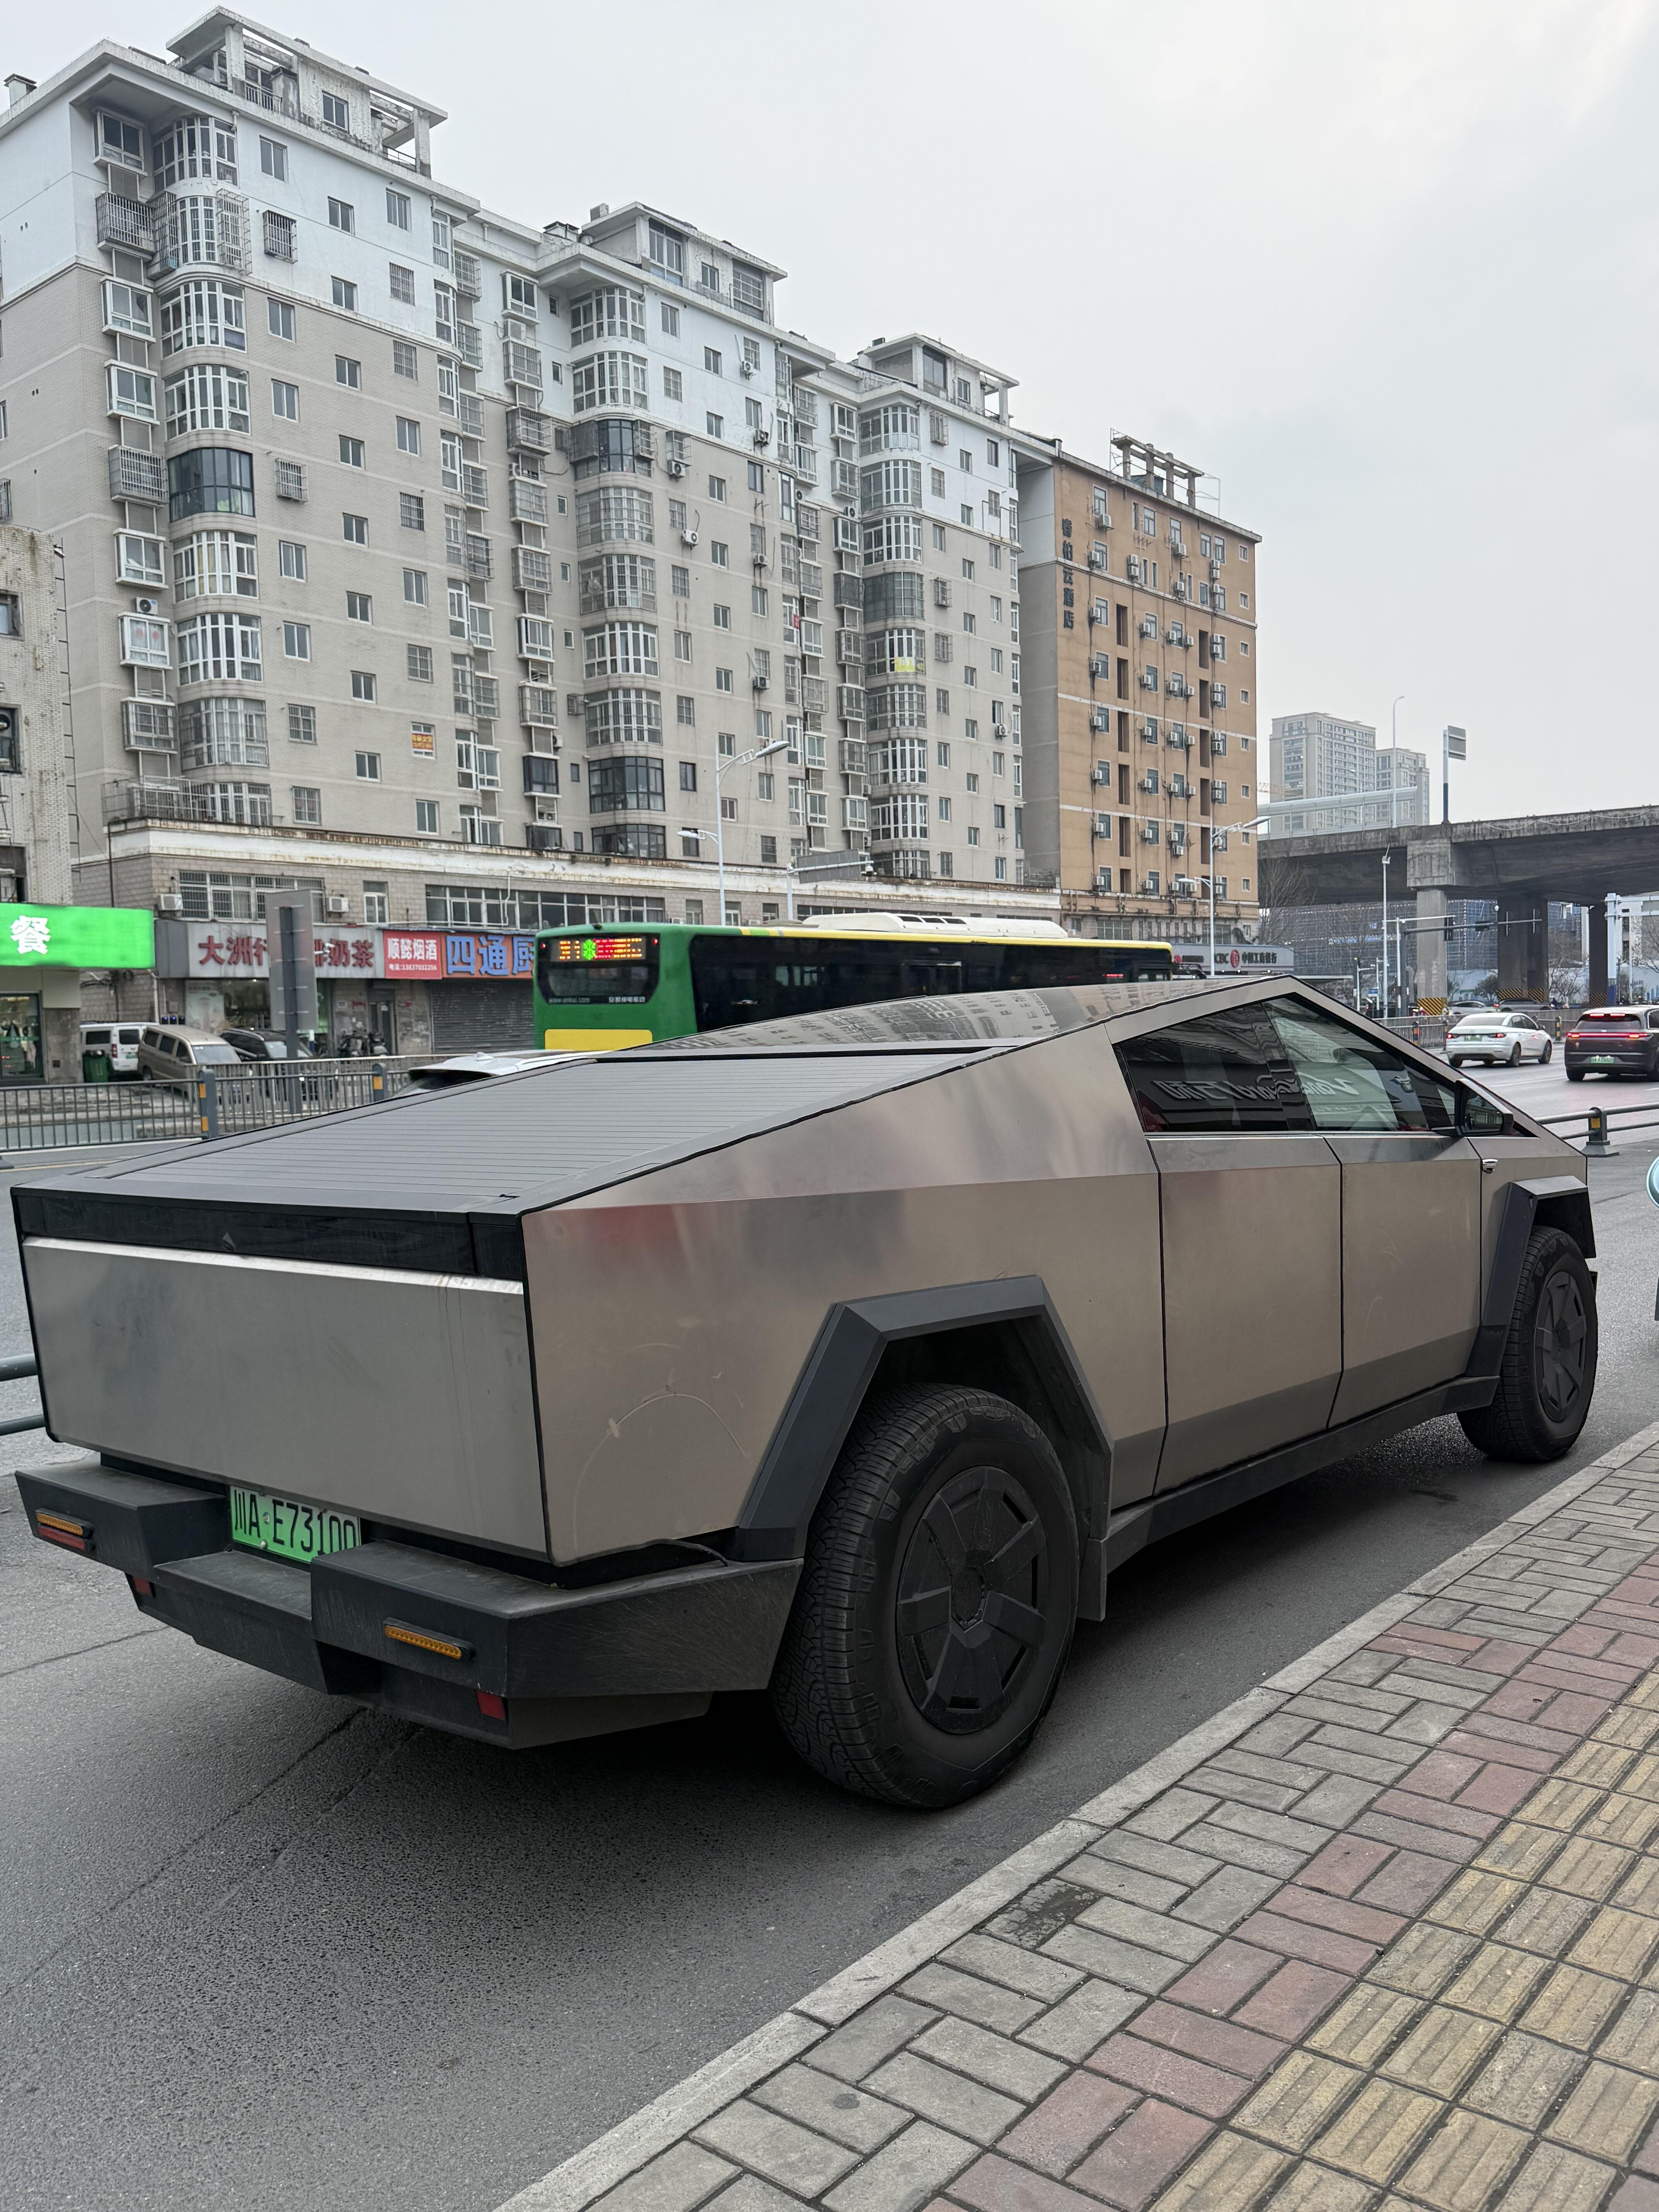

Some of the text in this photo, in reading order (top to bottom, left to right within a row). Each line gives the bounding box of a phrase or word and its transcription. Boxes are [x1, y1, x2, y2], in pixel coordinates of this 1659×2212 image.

[10, 915, 52, 955] 餐
[199, 935, 375, 968] 大洲奶茶
[446, 935, 535, 975] 四通厨
